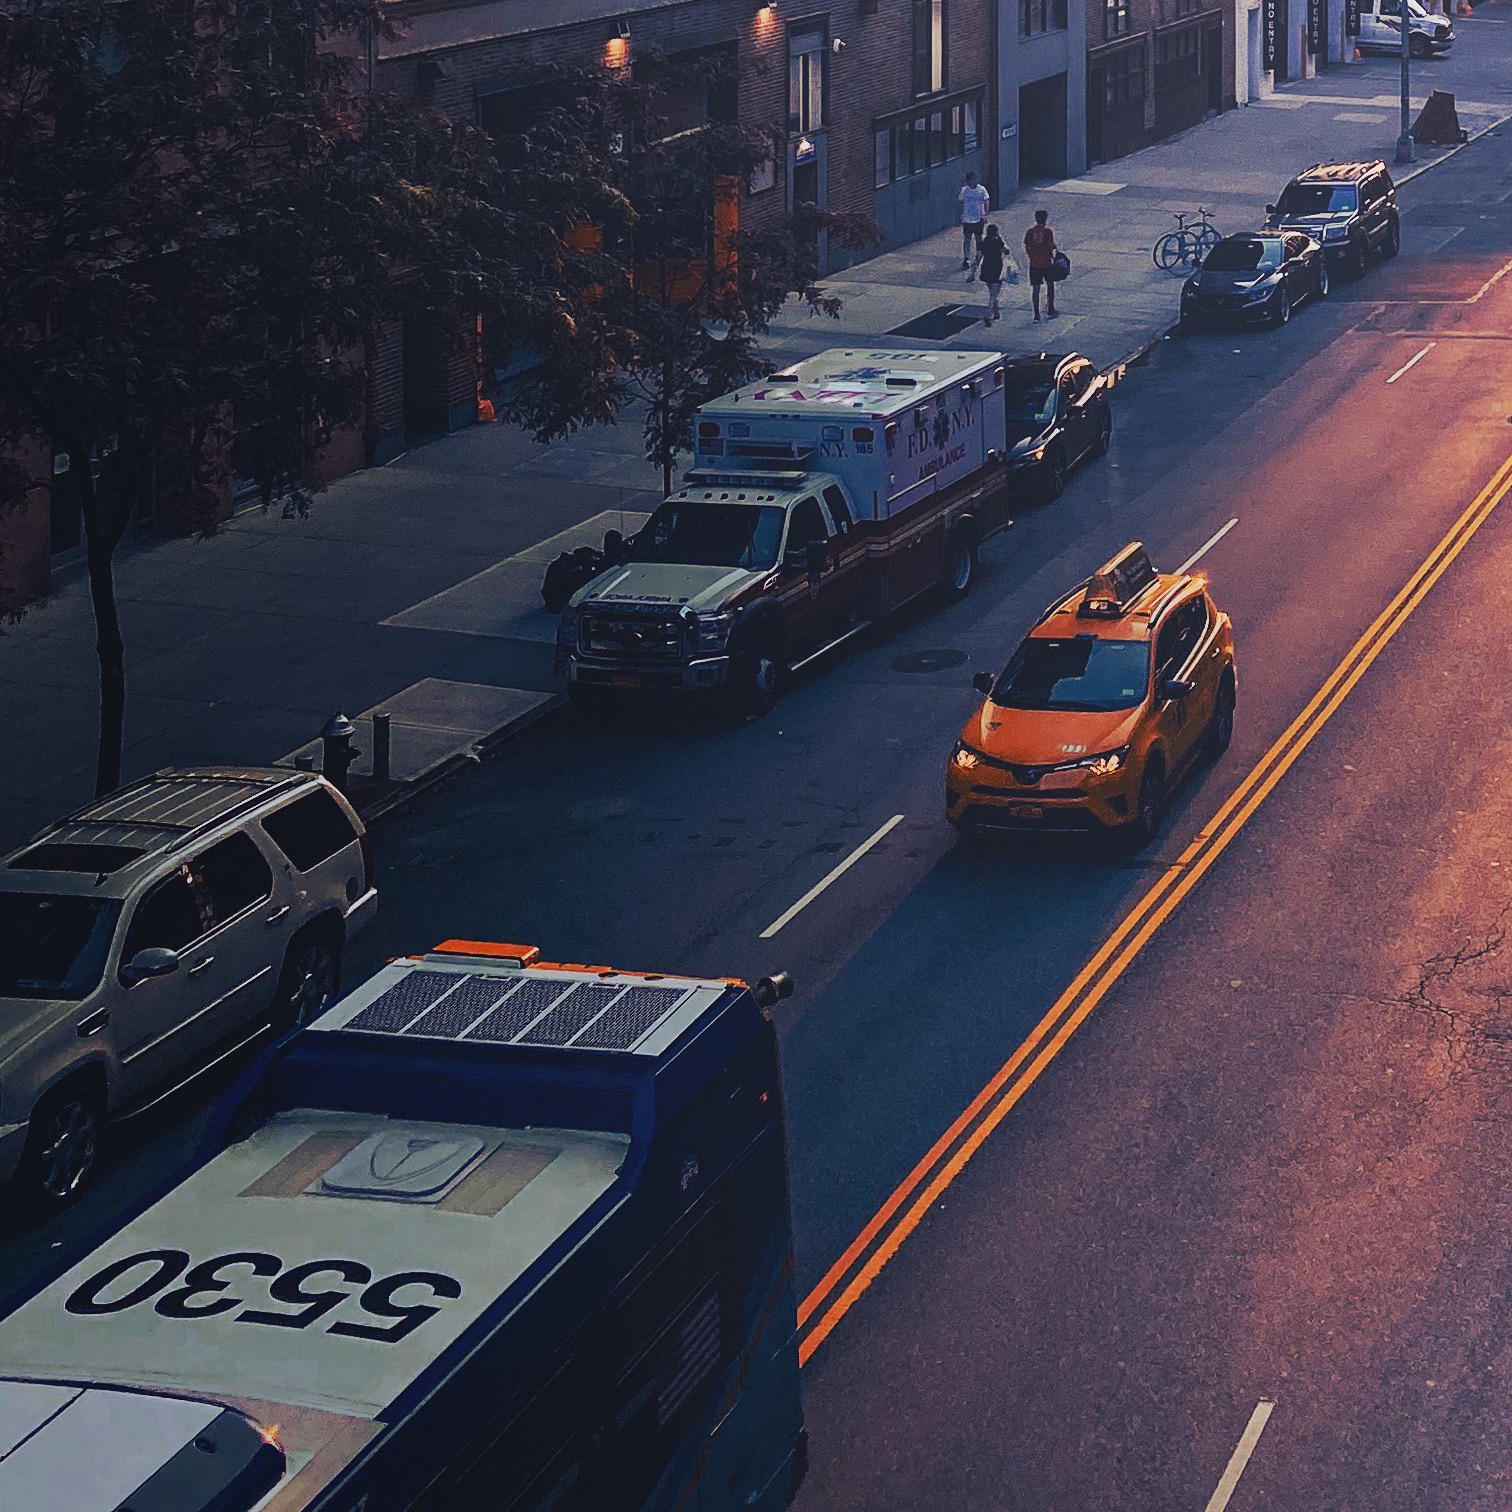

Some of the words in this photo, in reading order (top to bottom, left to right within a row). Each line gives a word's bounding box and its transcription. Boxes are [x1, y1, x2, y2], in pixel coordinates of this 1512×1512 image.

[1267, 2, 1276, 18] NO
[1312, 7, 1320, 46] ENTRY
[1267, 20, 1276, 62] ENTRY
[854, 443, 874, 455] 185
[918, 442, 967, 479] AMBULANCE
[63, 1248, 463, 1344] 5530
